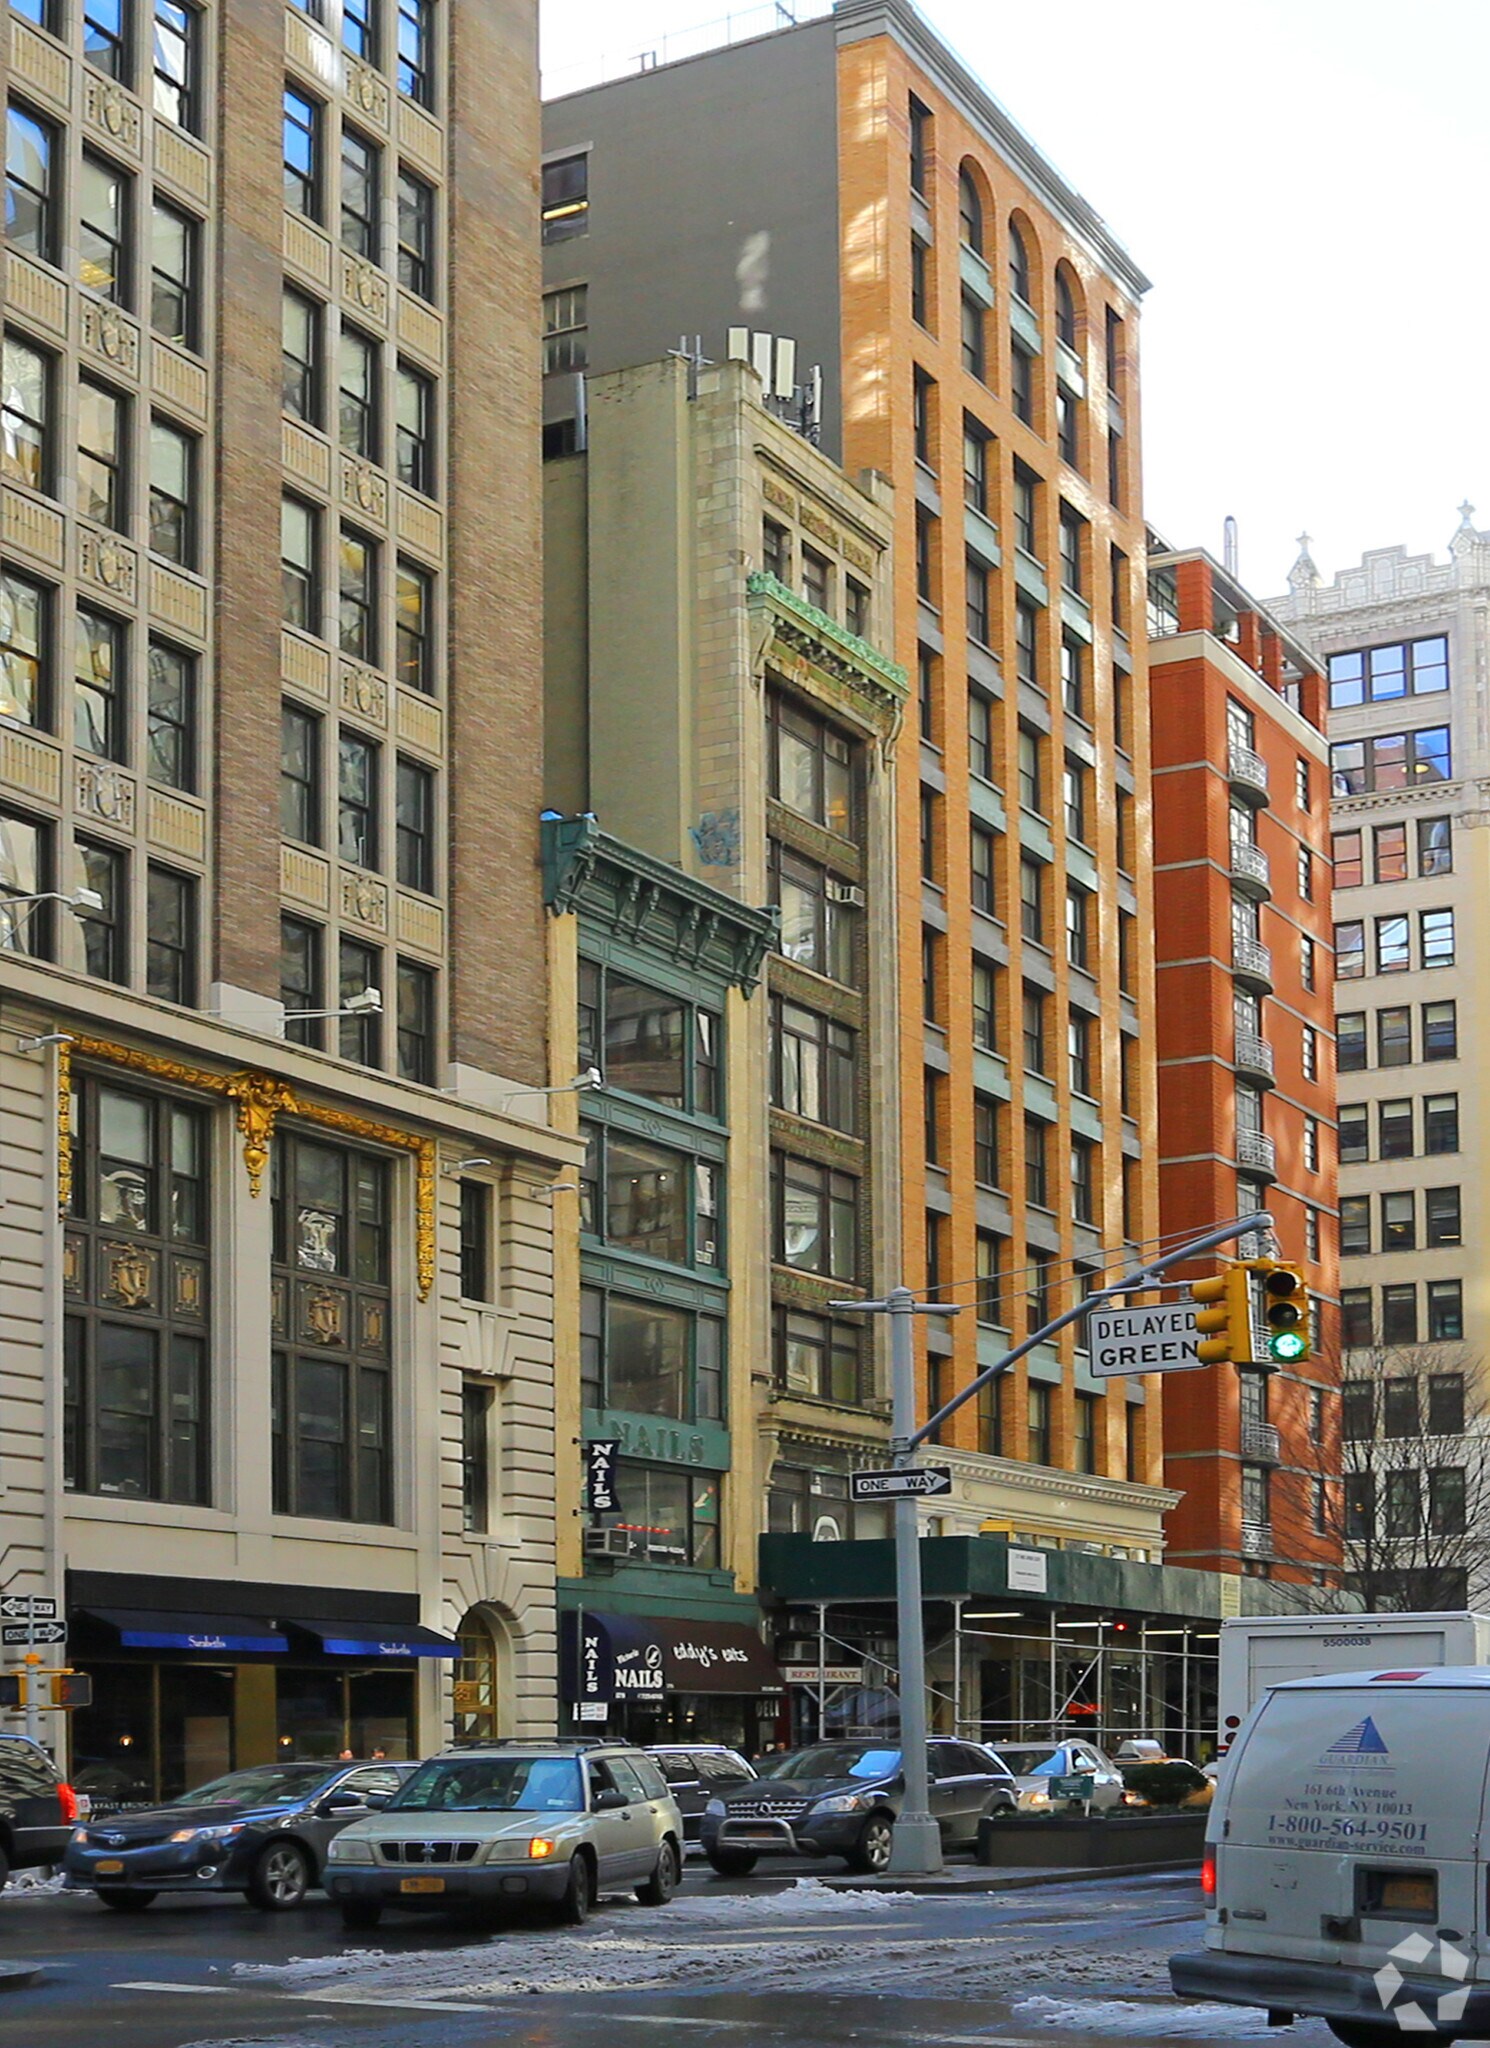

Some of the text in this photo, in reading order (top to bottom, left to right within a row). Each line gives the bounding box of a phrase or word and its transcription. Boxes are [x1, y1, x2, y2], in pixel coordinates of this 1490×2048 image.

[1098, 1312, 1197, 1339] DELAYED
[1099, 1341, 1199, 1366] GREEN
[610, 1420, 704, 1463] NAILS
[591, 1444, 613, 1508] NAILS
[860, 1476, 937, 1491] ONE WAY
[1322, 1638, 1371, 1647] 5500038
[673, 1642, 749, 1668] eddy's eats
[584, 1637, 599, 1693] NAILS
[614, 1669, 663, 1688] NAILS
[791, 1671, 858, 1679] RESTURANT
[1319, 1754, 1390, 1765] GUARDIAN
[1326, 1785, 1346, 1796] 6th
[1352, 1786, 1397, 1799] Avenue
[1285, 1798, 1309, 1810] New
[1350, 1801, 1371, 1813] NY
[1375, 1803, 1413, 1815] 10013
[1268, 1814, 1428, 1841] 1-800-564-9501
[1268, 1836, 1426, 1855] www.guardian-service.com
